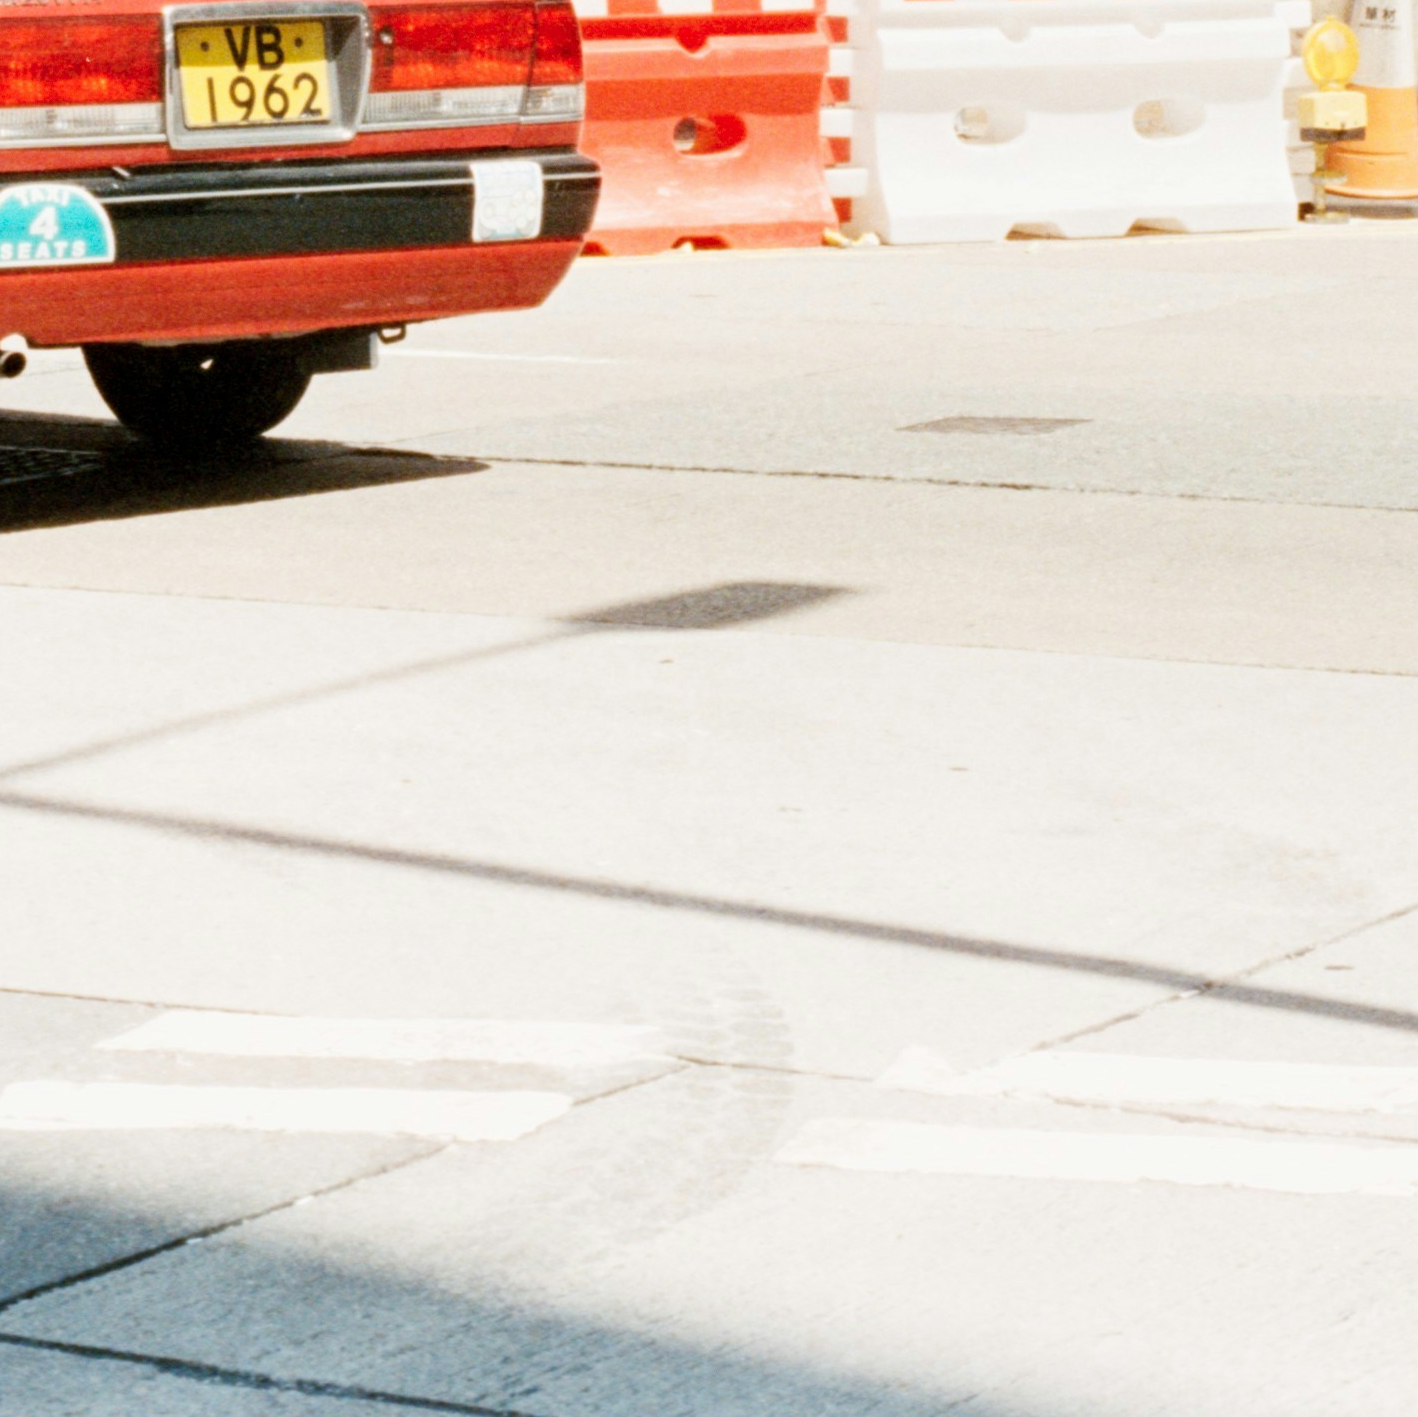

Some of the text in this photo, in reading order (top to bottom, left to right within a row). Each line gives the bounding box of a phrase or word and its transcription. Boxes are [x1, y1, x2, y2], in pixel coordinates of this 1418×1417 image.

[224, 24, 285, 72] VB
[206, 72, 323, 124] 1962
[18, 188, 71, 208] TAXI
[28, 204, 58, 237] 4
